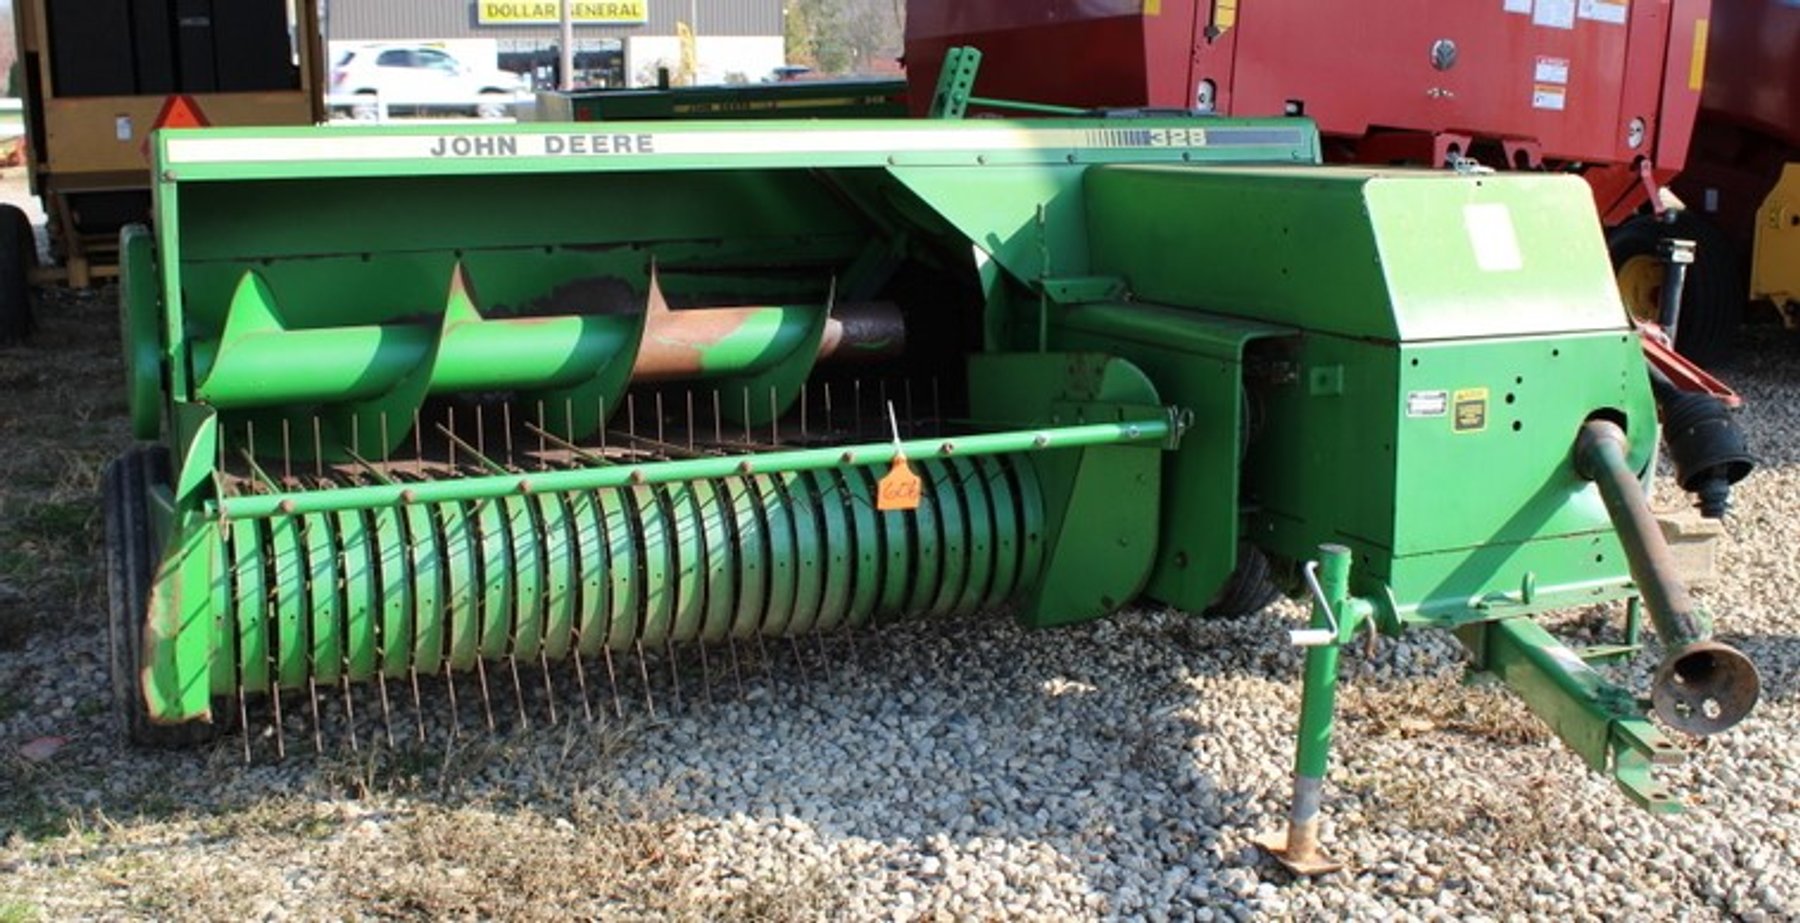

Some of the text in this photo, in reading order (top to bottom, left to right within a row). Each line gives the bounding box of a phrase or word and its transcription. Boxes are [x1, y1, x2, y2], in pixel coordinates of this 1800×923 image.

[486, 3, 640, 18] DOLLAR ENERAL
[430, 134, 654, 156] JOHN DEERE
[1150, 128, 1207, 147] 328
